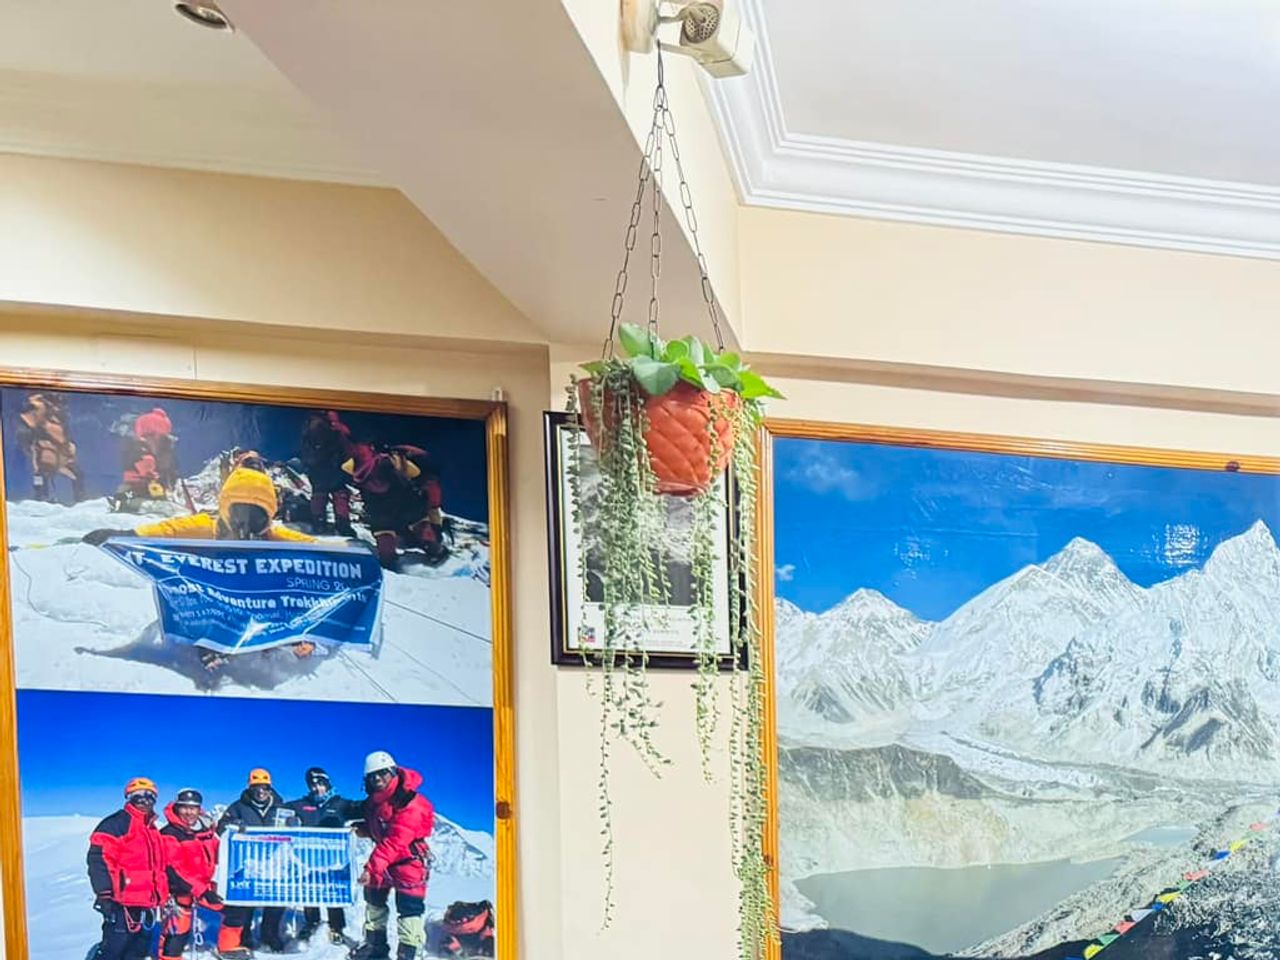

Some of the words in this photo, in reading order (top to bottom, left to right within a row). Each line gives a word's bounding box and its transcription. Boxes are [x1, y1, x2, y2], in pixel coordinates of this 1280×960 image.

[161, 554, 248, 575] EVEREST
[255, 558, 362, 579] EXPEDITION
[286, 577, 330, 590] SPRING
